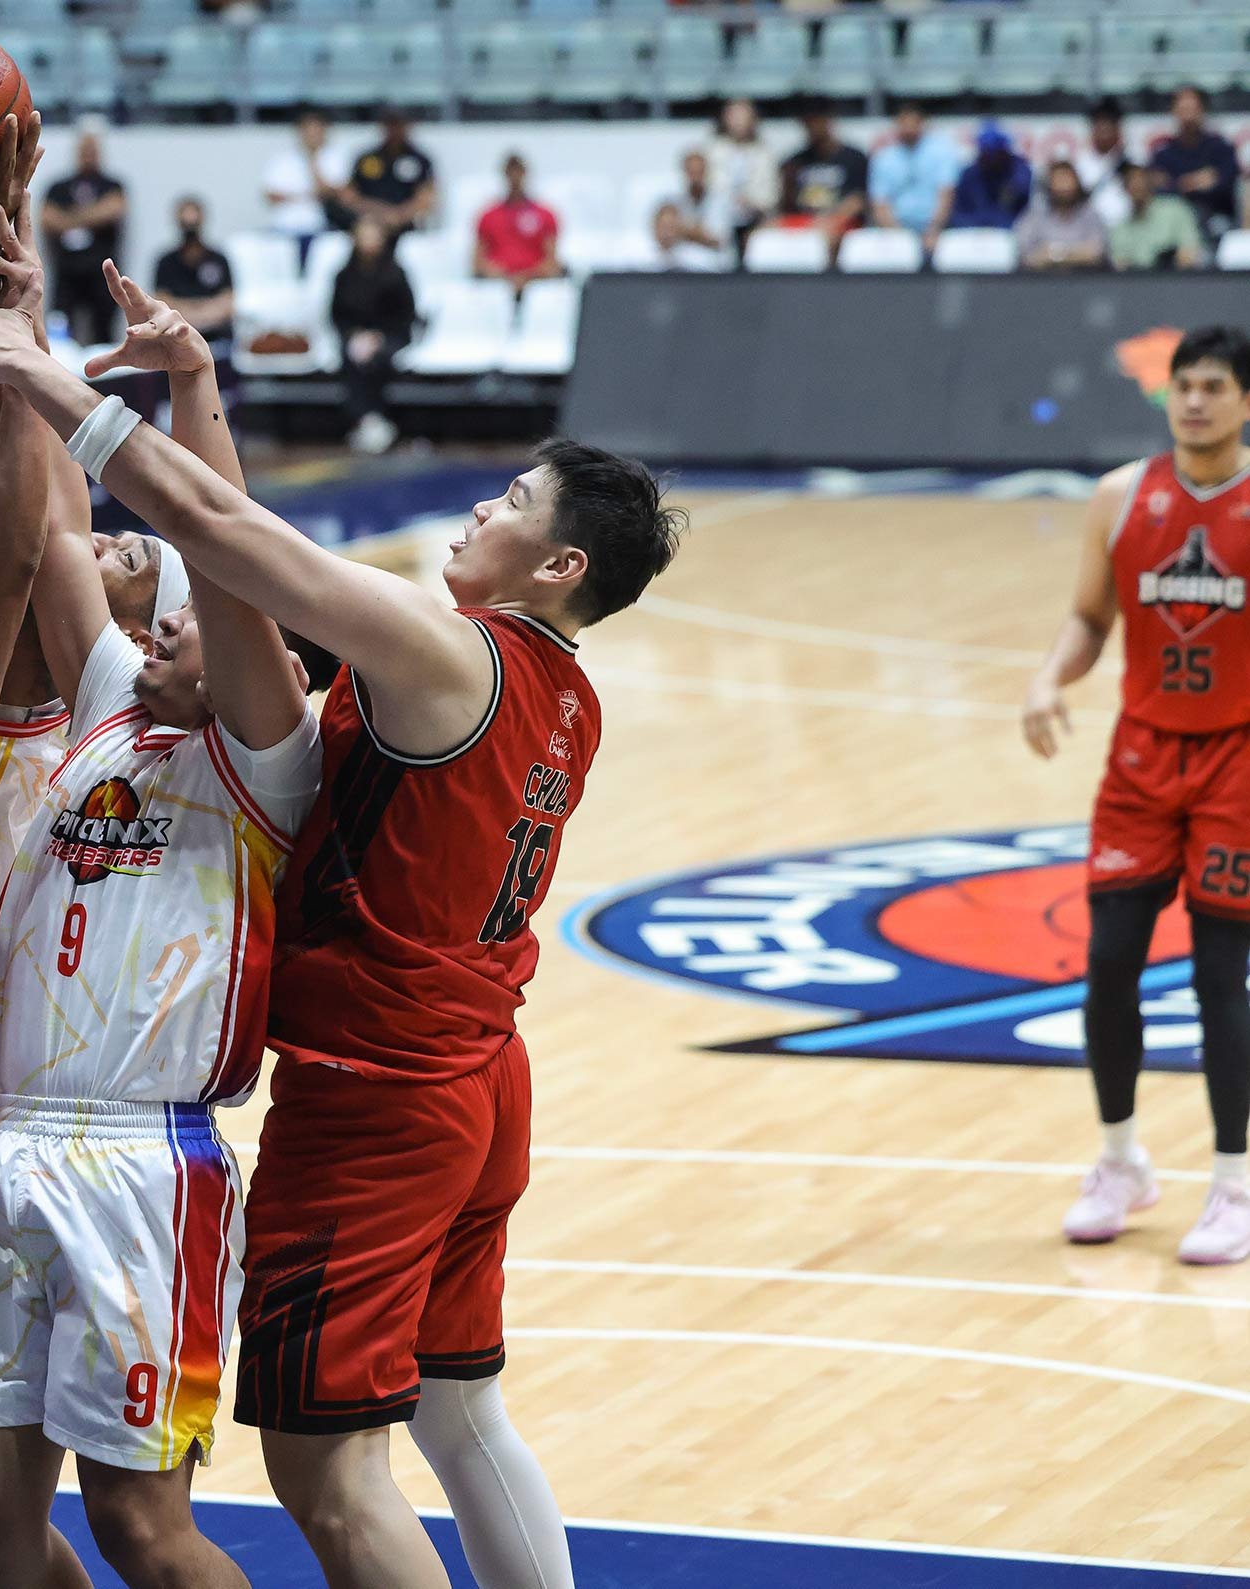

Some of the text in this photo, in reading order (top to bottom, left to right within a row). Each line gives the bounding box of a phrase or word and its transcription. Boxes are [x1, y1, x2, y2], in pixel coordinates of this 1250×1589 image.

[1161, 645, 1214, 693] 25
[477, 816, 555, 944] 18
[1200, 845, 1250, 897] 25
[57, 902, 88, 978] 9
[123, 1361, 159, 1428] 9
